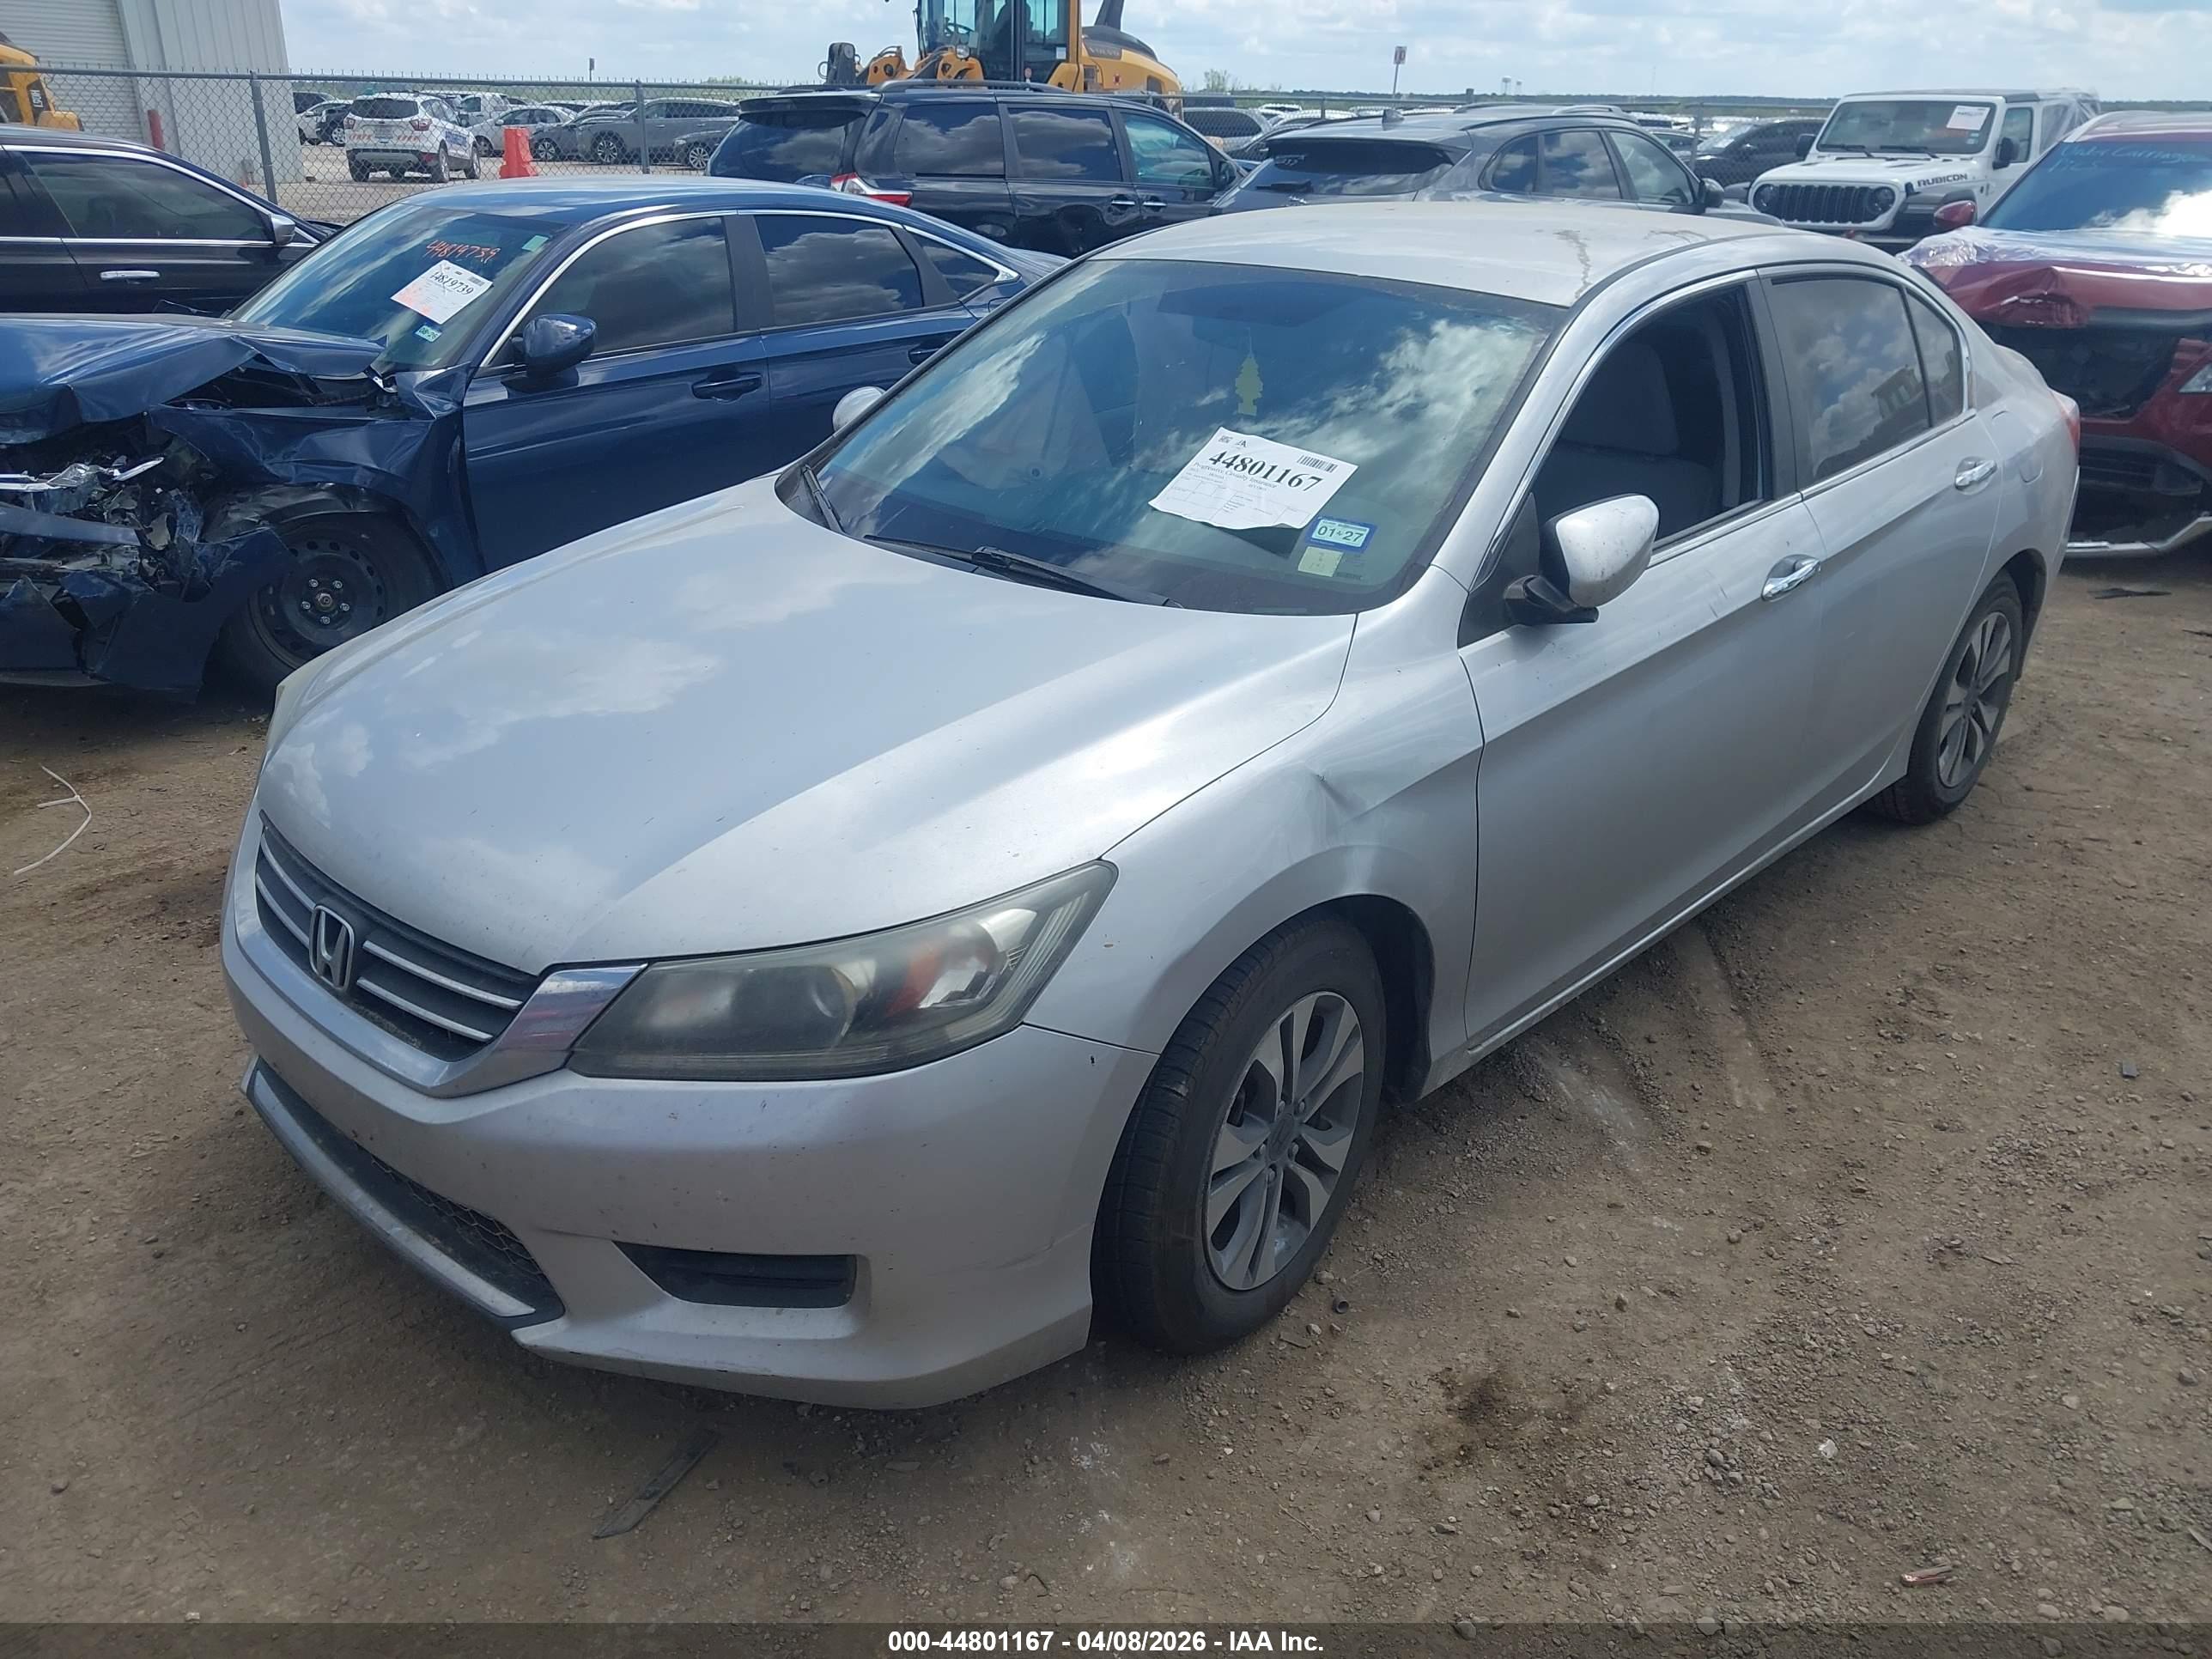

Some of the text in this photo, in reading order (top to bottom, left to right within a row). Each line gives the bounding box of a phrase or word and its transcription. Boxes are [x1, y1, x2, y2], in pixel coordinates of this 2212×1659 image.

[1917, 173, 1968, 187] RUBICON
[422, 240, 501, 264] 44819739
[1209, 450, 1324, 492] 44801167
